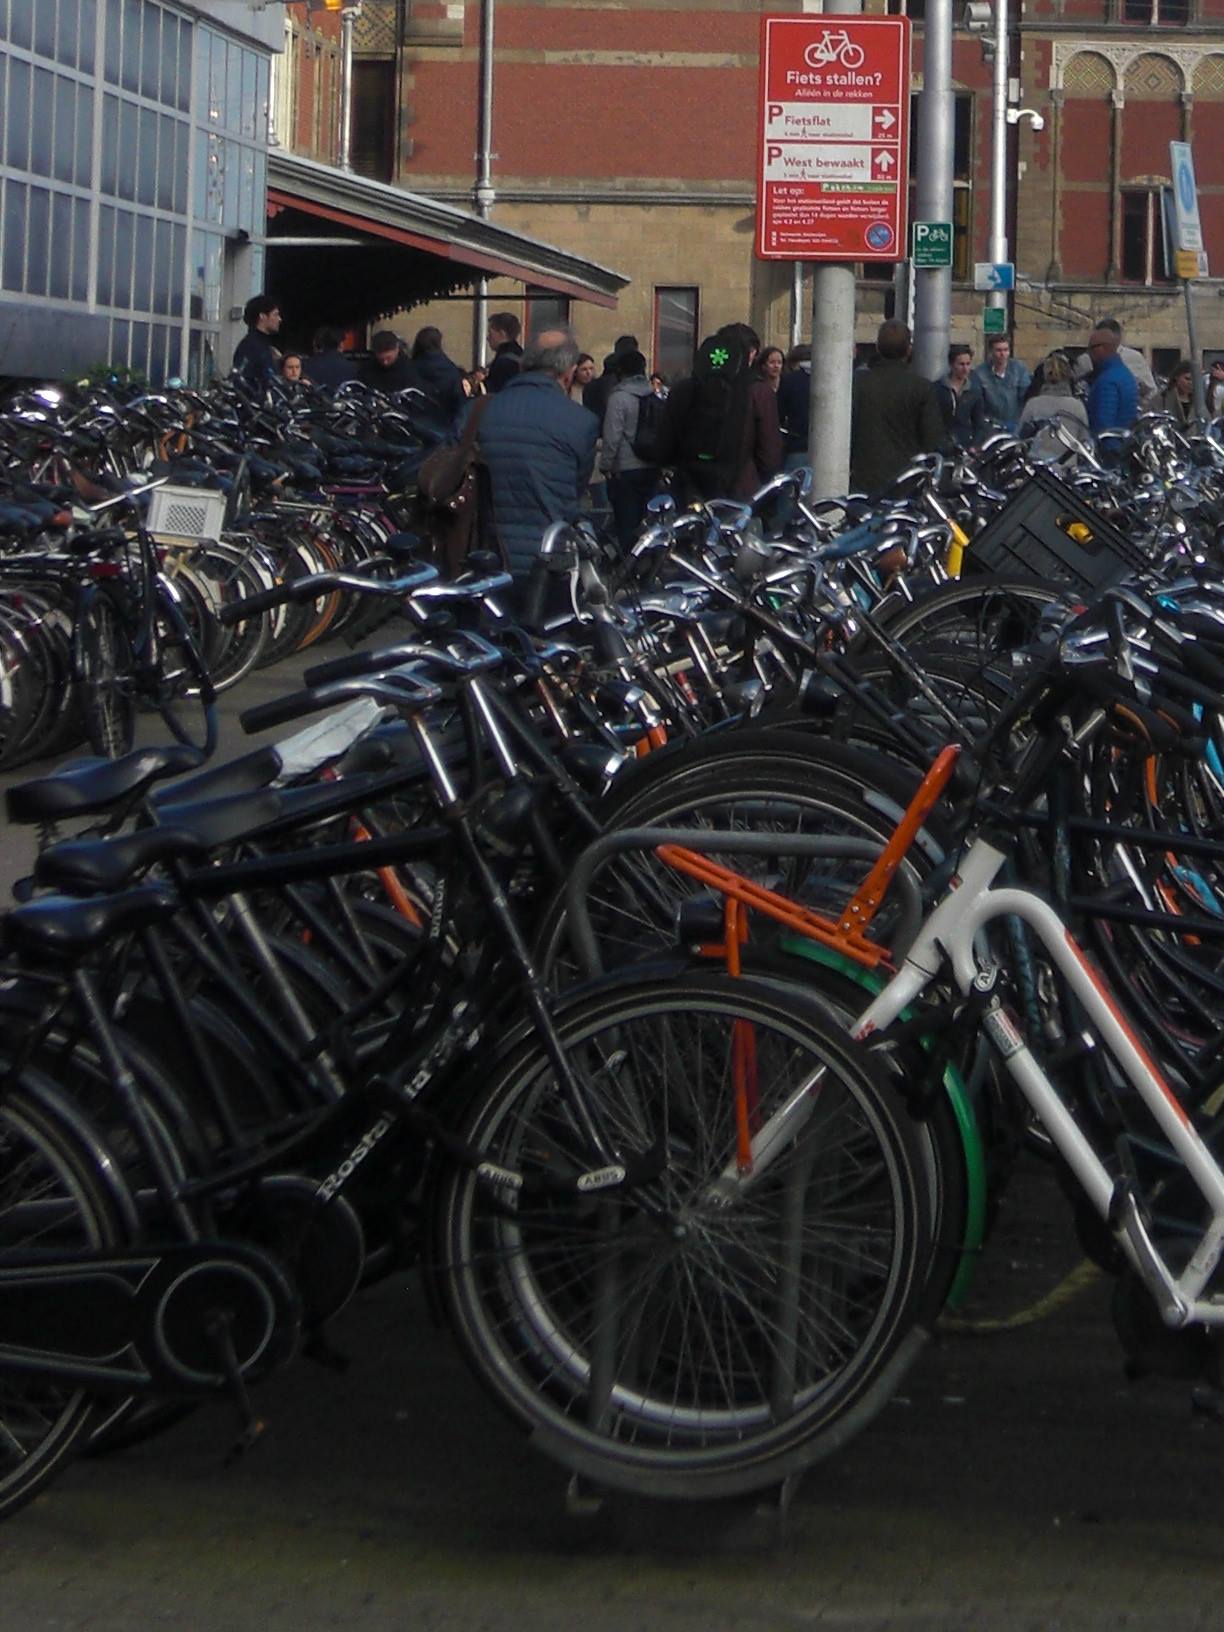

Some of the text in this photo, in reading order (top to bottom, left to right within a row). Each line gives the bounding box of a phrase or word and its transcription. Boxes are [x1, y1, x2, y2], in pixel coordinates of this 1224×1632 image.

[786, 71, 883, 86] Fiets stallen?
[823, 89, 831, 97] in
[832, 89, 844, 97] de
[845, 89, 873, 98] rekken
[768, 105, 783, 124] P
[785, 116, 831, 126] Fietsflat
[767, 146, 782, 166] P
[783, 157, 865, 168] West bewaakt
[772, 187, 787, 195] Let
[917, 225, 930, 241] P
[583, 1170, 619, 1186] ABUS
